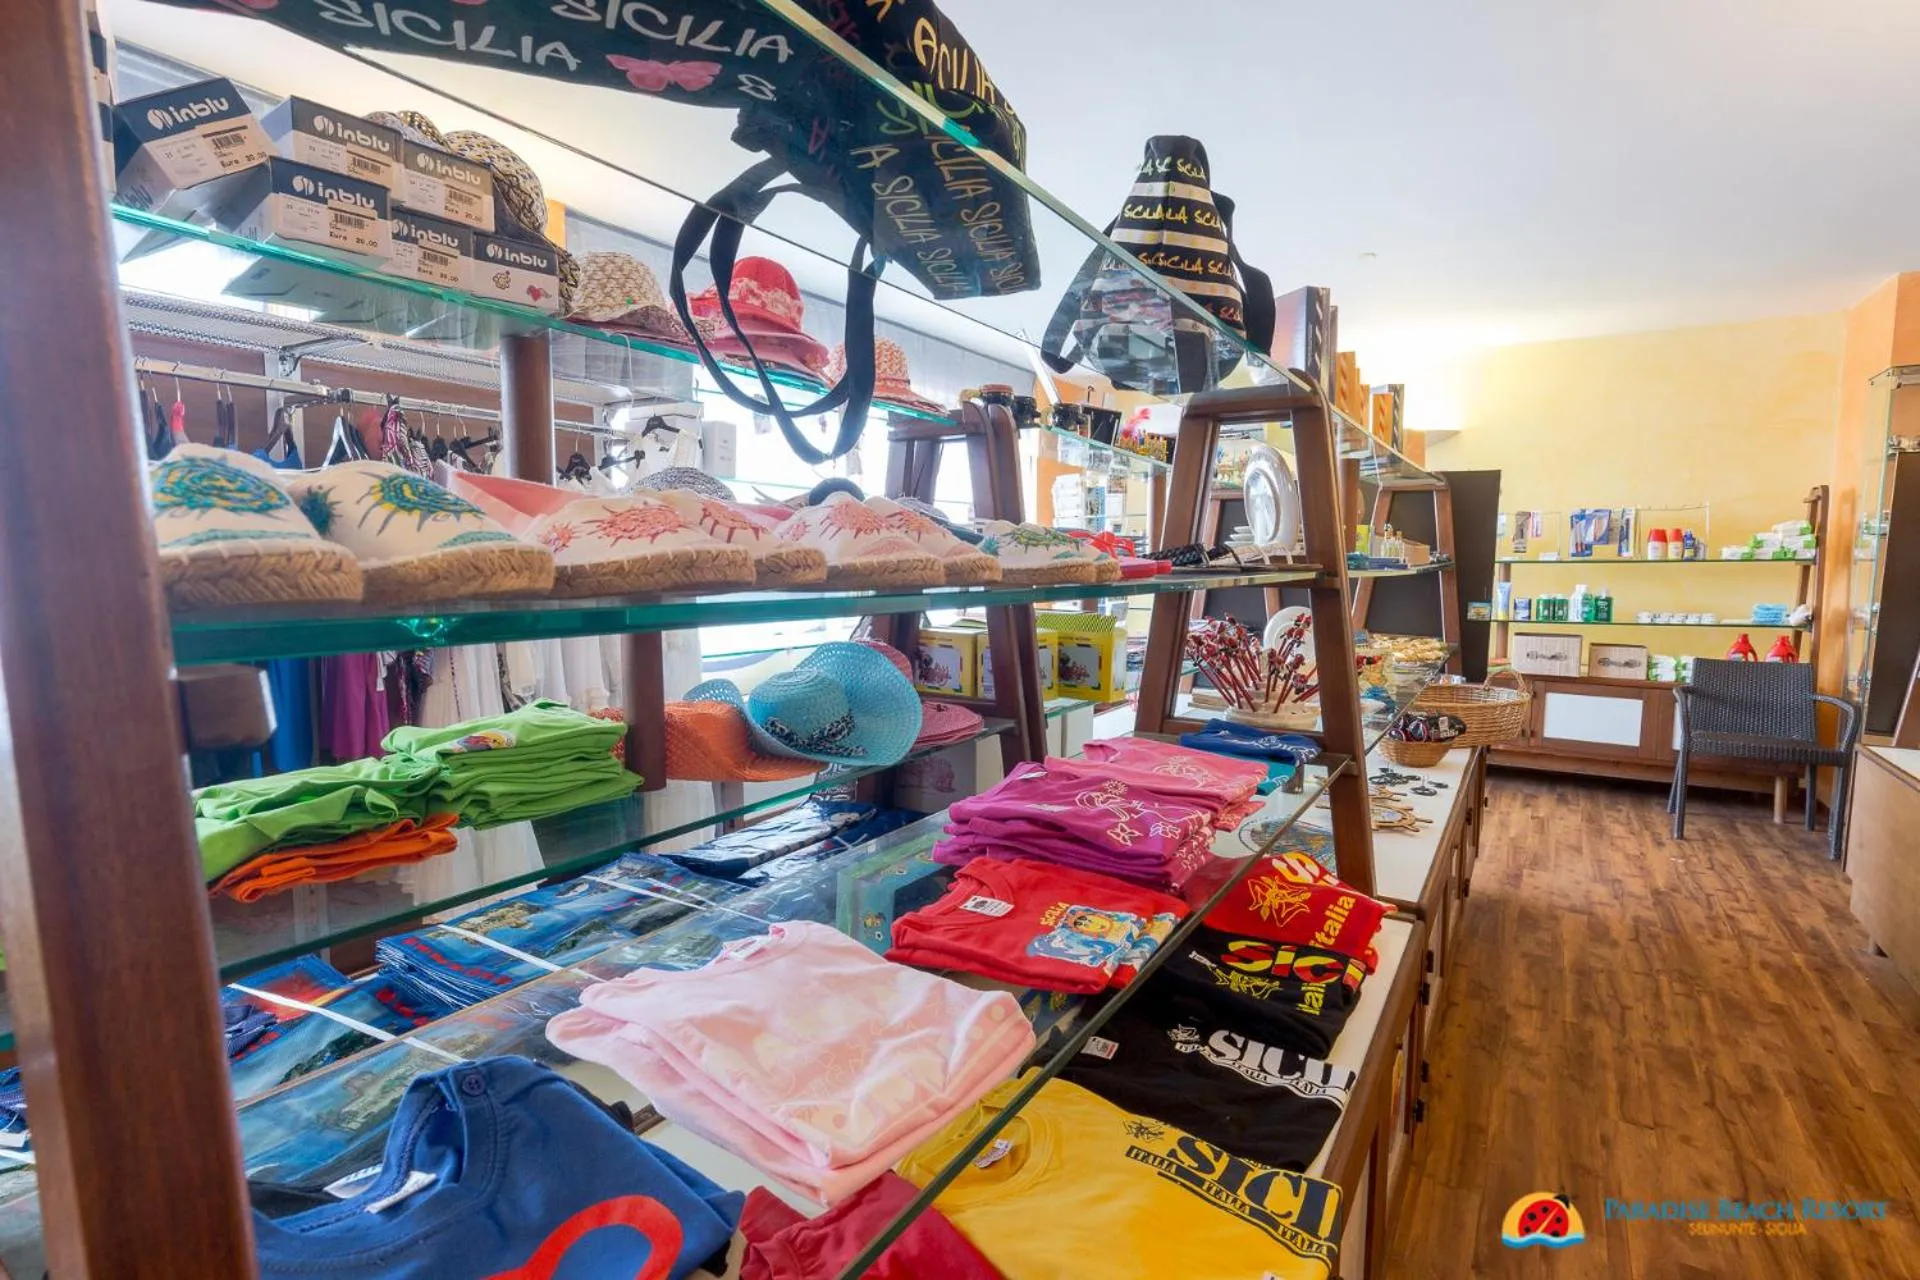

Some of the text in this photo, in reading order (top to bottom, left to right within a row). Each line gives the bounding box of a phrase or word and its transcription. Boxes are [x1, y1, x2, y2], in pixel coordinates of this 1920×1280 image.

[314, 0, 583, 71] SICILIA
[169, 97, 230, 123] inblu
[337, 122, 390, 152] inblu
[435, 159, 481, 185] inblu
[317, 181, 375, 209] inblu
[872, 175, 943, 244] SICILIA
[410, 224, 459, 247] inblu
[505, 248, 548, 269] inblu
[1129, 1147, 1179, 1175] ITALIA
[1202, 1180, 1251, 1216] ITALIA
